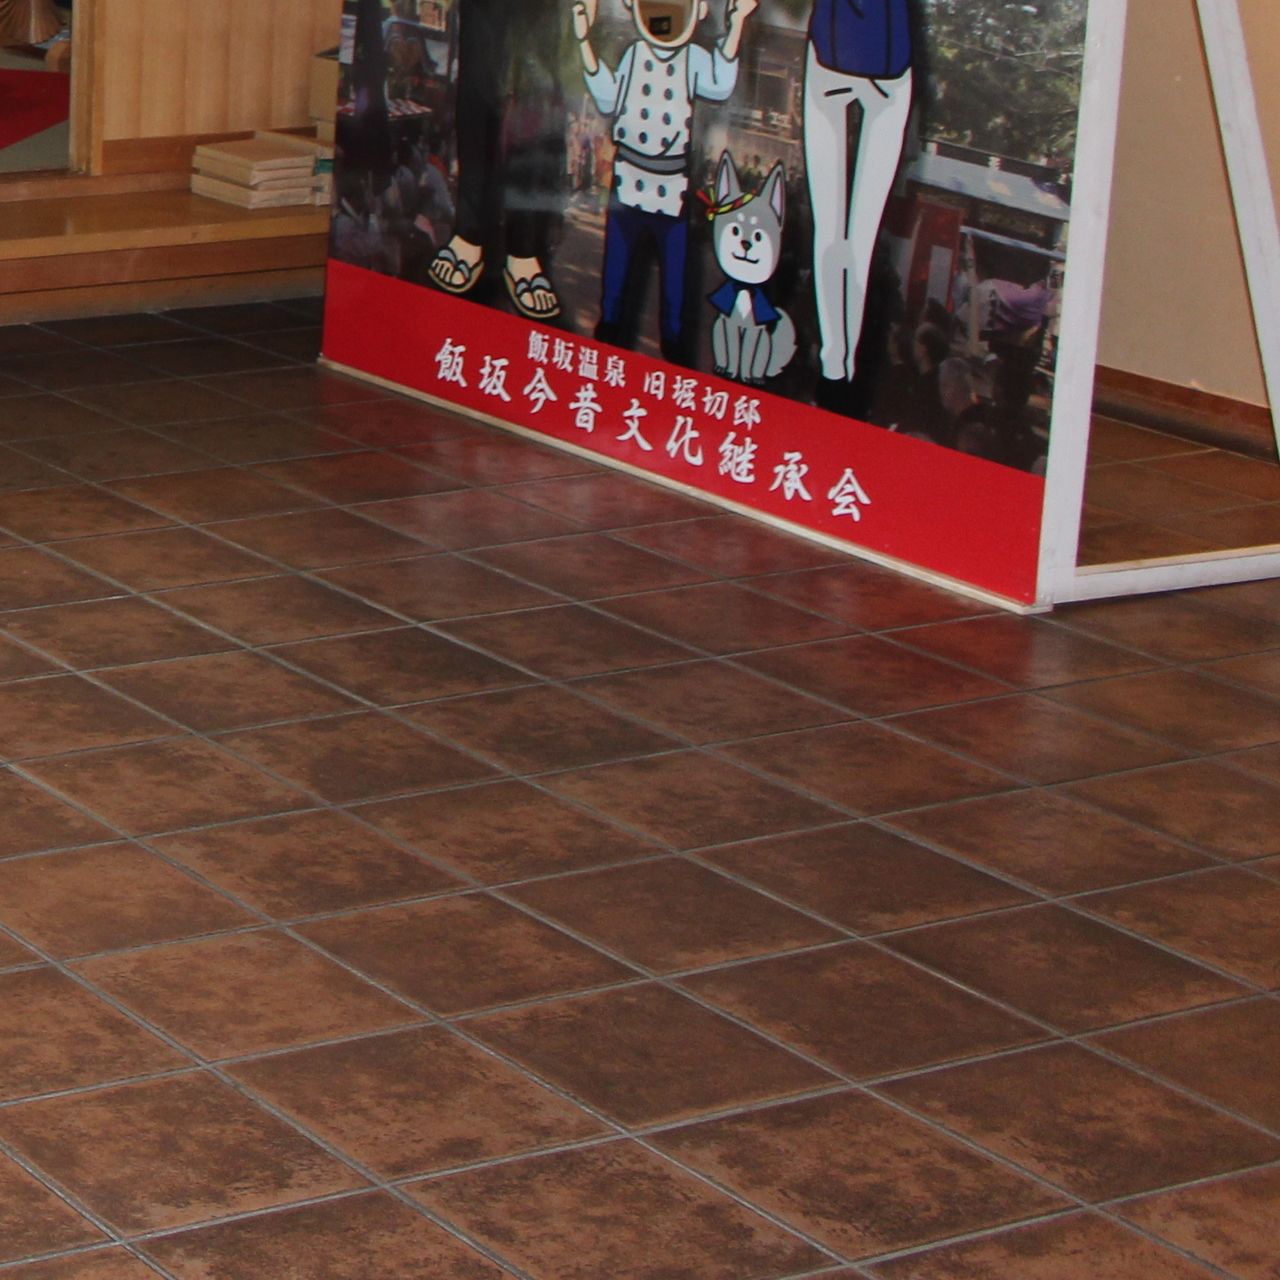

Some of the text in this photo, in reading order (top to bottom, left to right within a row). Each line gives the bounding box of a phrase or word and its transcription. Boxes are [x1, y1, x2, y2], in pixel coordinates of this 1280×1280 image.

[434, 337, 872, 522] 飯坂今昔文化継承会
[527, 331, 762, 431] 飯坂温泉 旧堀切邸
